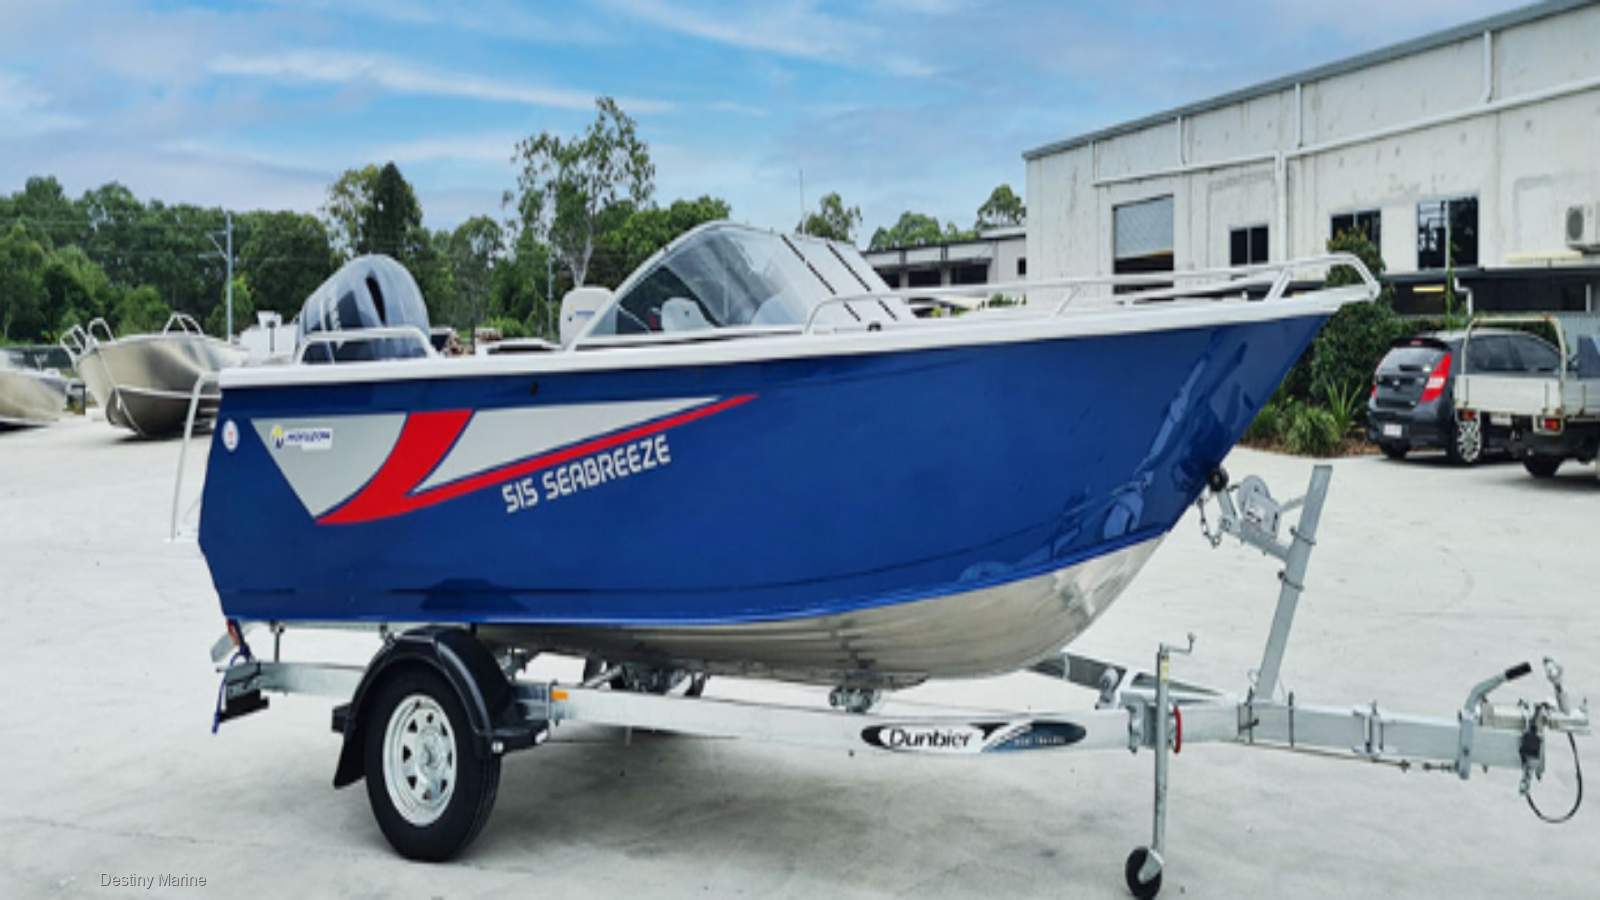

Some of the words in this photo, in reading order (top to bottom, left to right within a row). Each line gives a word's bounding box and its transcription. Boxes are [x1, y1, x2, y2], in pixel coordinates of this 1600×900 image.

[502, 477, 538, 513] 515
[542, 434, 671, 500] SEABREEZE
[889, 728, 971, 748] Dunbier
